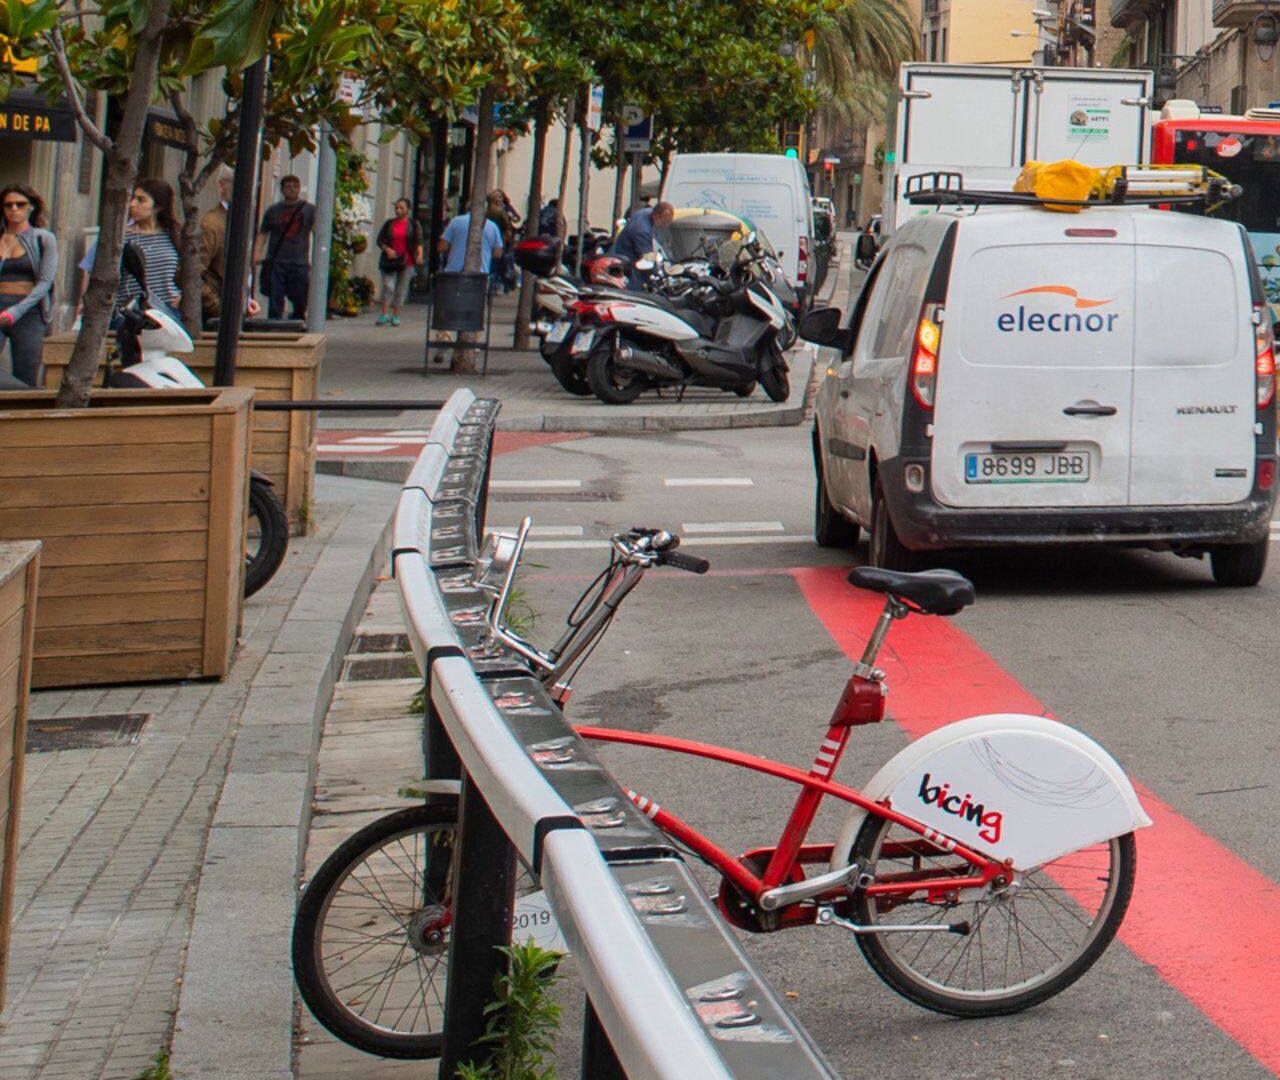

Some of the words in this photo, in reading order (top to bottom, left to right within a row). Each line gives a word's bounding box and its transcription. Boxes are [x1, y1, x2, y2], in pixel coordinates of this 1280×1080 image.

[13, 114, 29, 132] DE
[35, 116, 50, 132] PA
[998, 305, 1119, 332] elecnor
[1176, 405, 1239, 415] RENAULT
[982, 457, 1036, 476] 8699
[1044, 456, 1084, 475] JBB
[918, 773, 1002, 844] bicing
